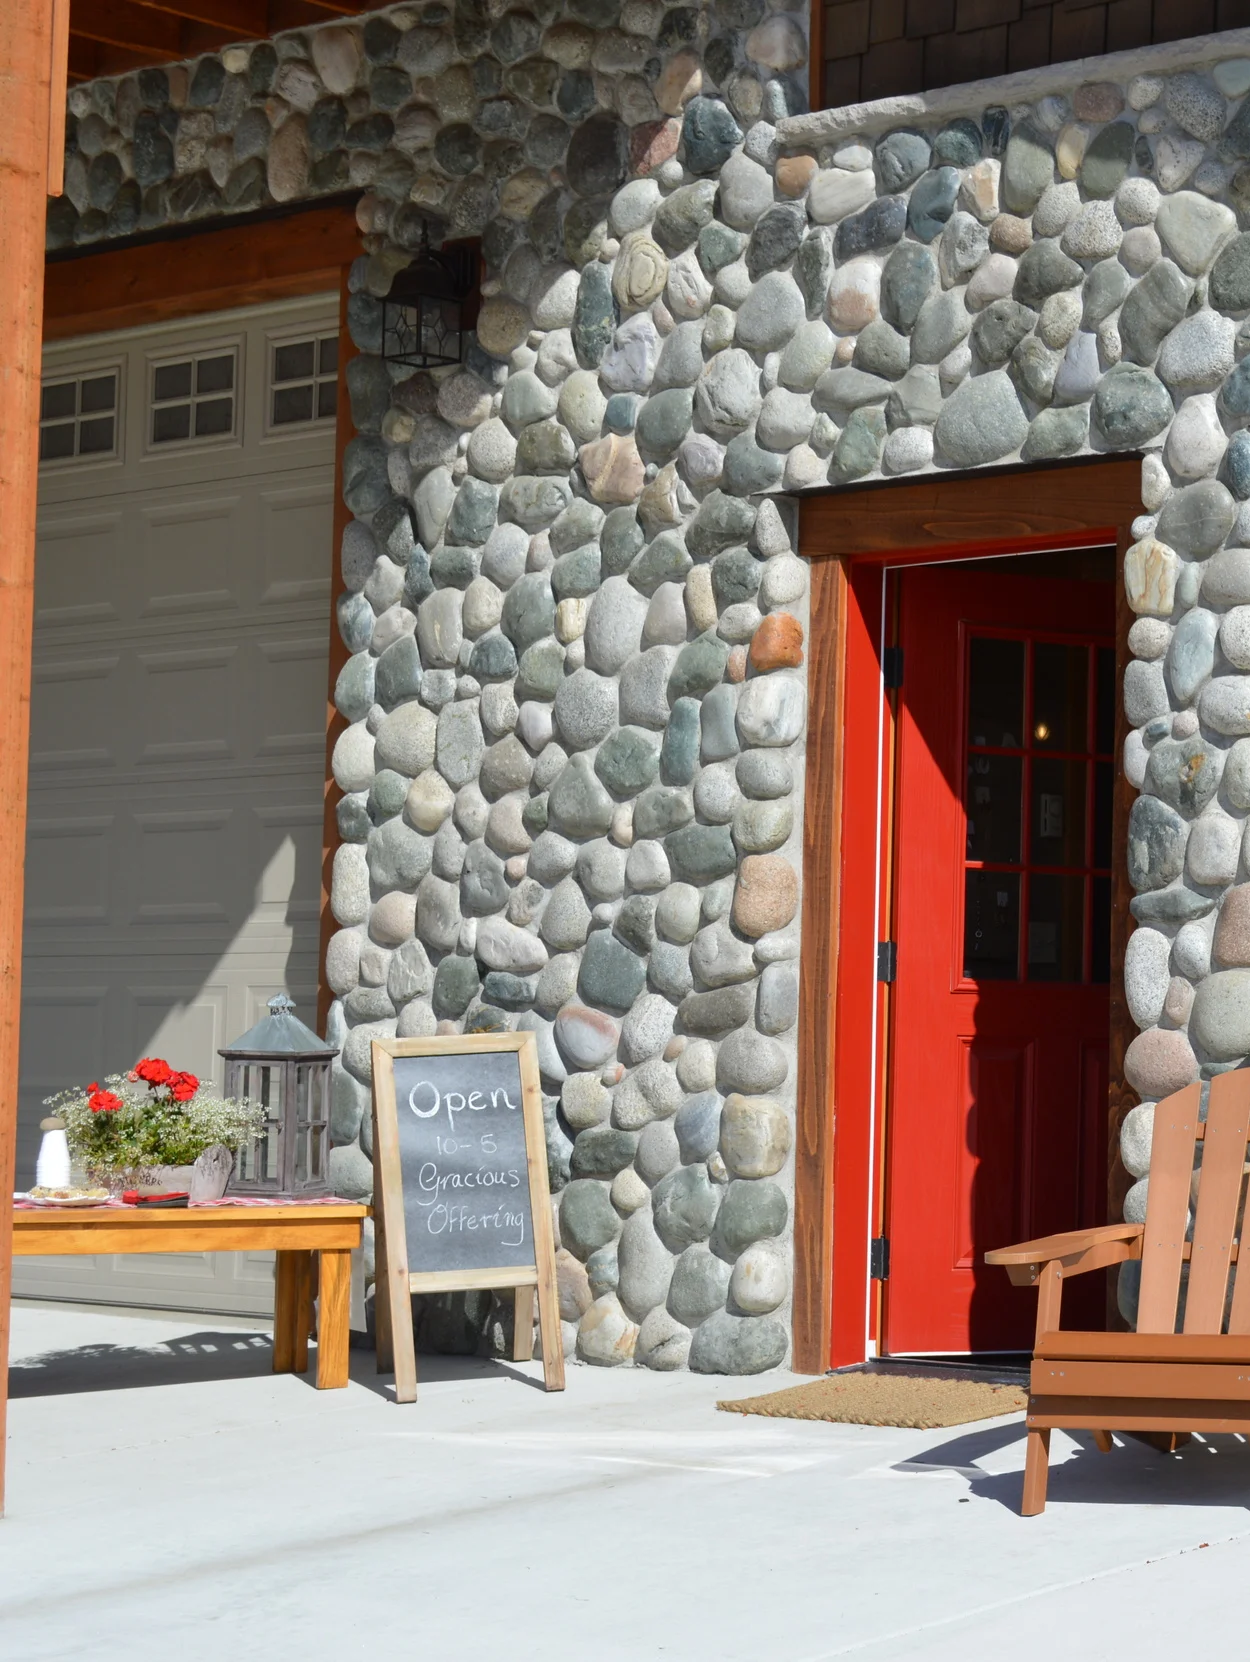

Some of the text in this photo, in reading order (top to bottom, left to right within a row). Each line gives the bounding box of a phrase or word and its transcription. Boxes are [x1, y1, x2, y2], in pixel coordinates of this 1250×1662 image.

[409, 1081, 517, 1132] Open
[417, 1162, 521, 1206] Gracious
[427, 1201, 524, 1246] Offering
